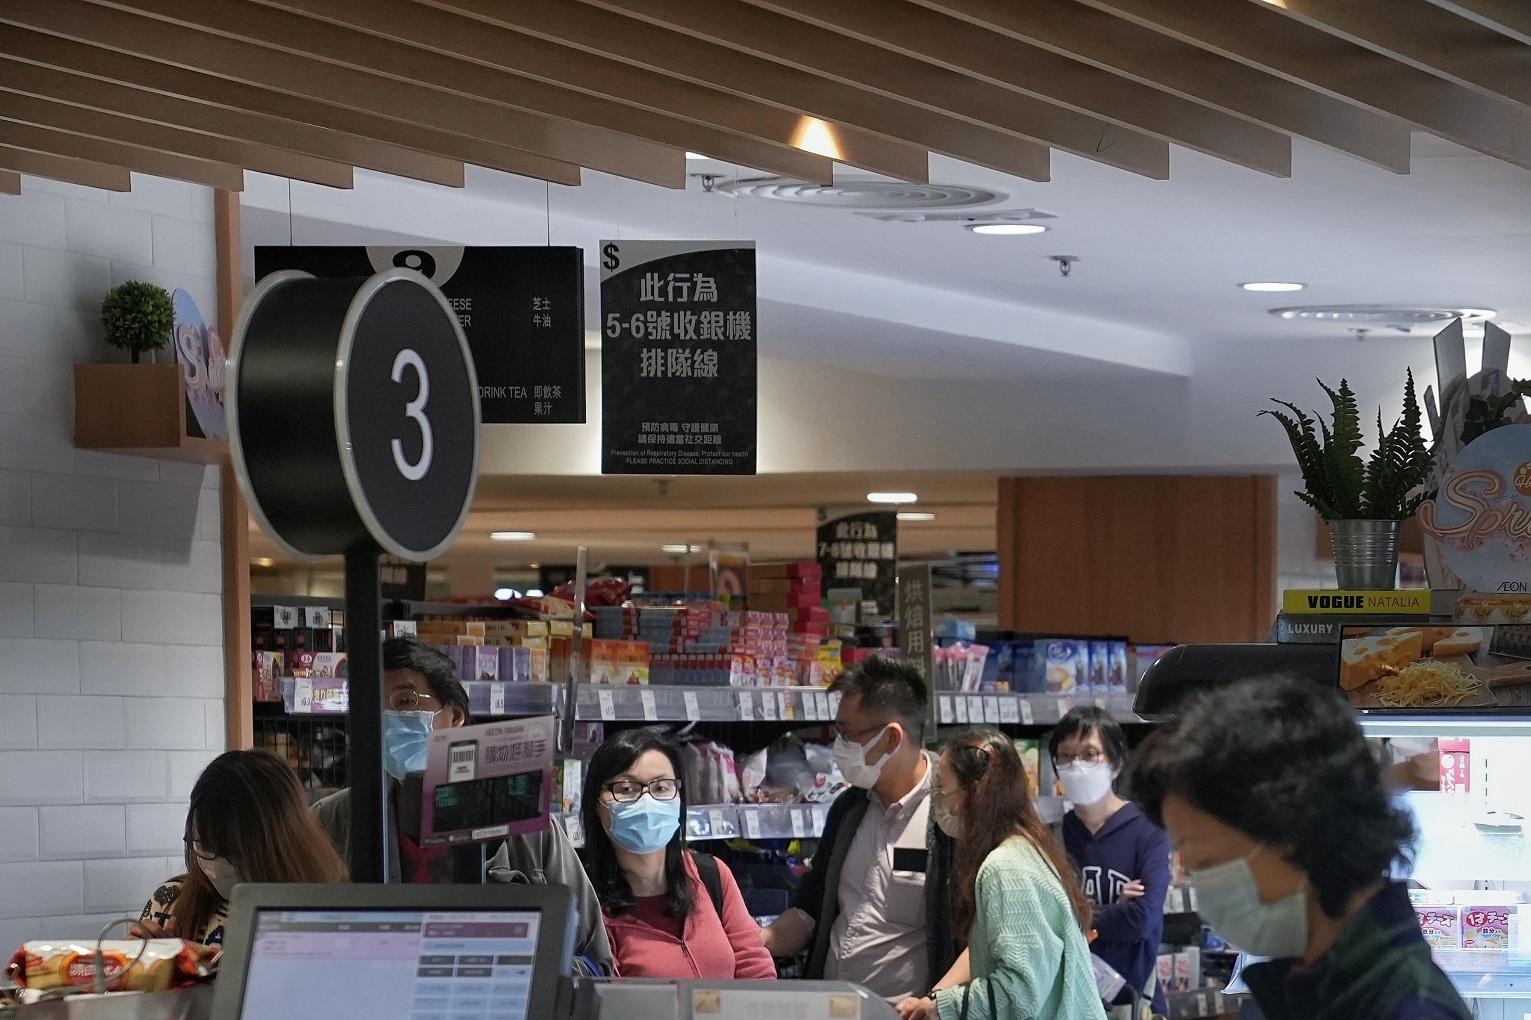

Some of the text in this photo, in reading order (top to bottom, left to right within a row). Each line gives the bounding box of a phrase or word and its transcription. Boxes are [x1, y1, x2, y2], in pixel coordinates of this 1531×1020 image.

[603, 242, 620, 272] $
[640, 272, 718, 302] 此行為
[447, 299, 472, 311] EESE
[532, 297, 551, 311] 芝士
[532, 314, 551, 328] 牛油
[606, 310, 752, 340] 5-6號收銀機
[640, 347, 718, 377] 排隊線
[479, 387, 527, 398] DRINK TEA
[534, 385, 562, 399] 即飲茶
[390, 348, 433, 482] 3
[534, 401, 552, 416] 果汁
[1308, 595, 1420, 608] VOGUE NATALIA
[1288, 624, 1333, 634] LUXURY
